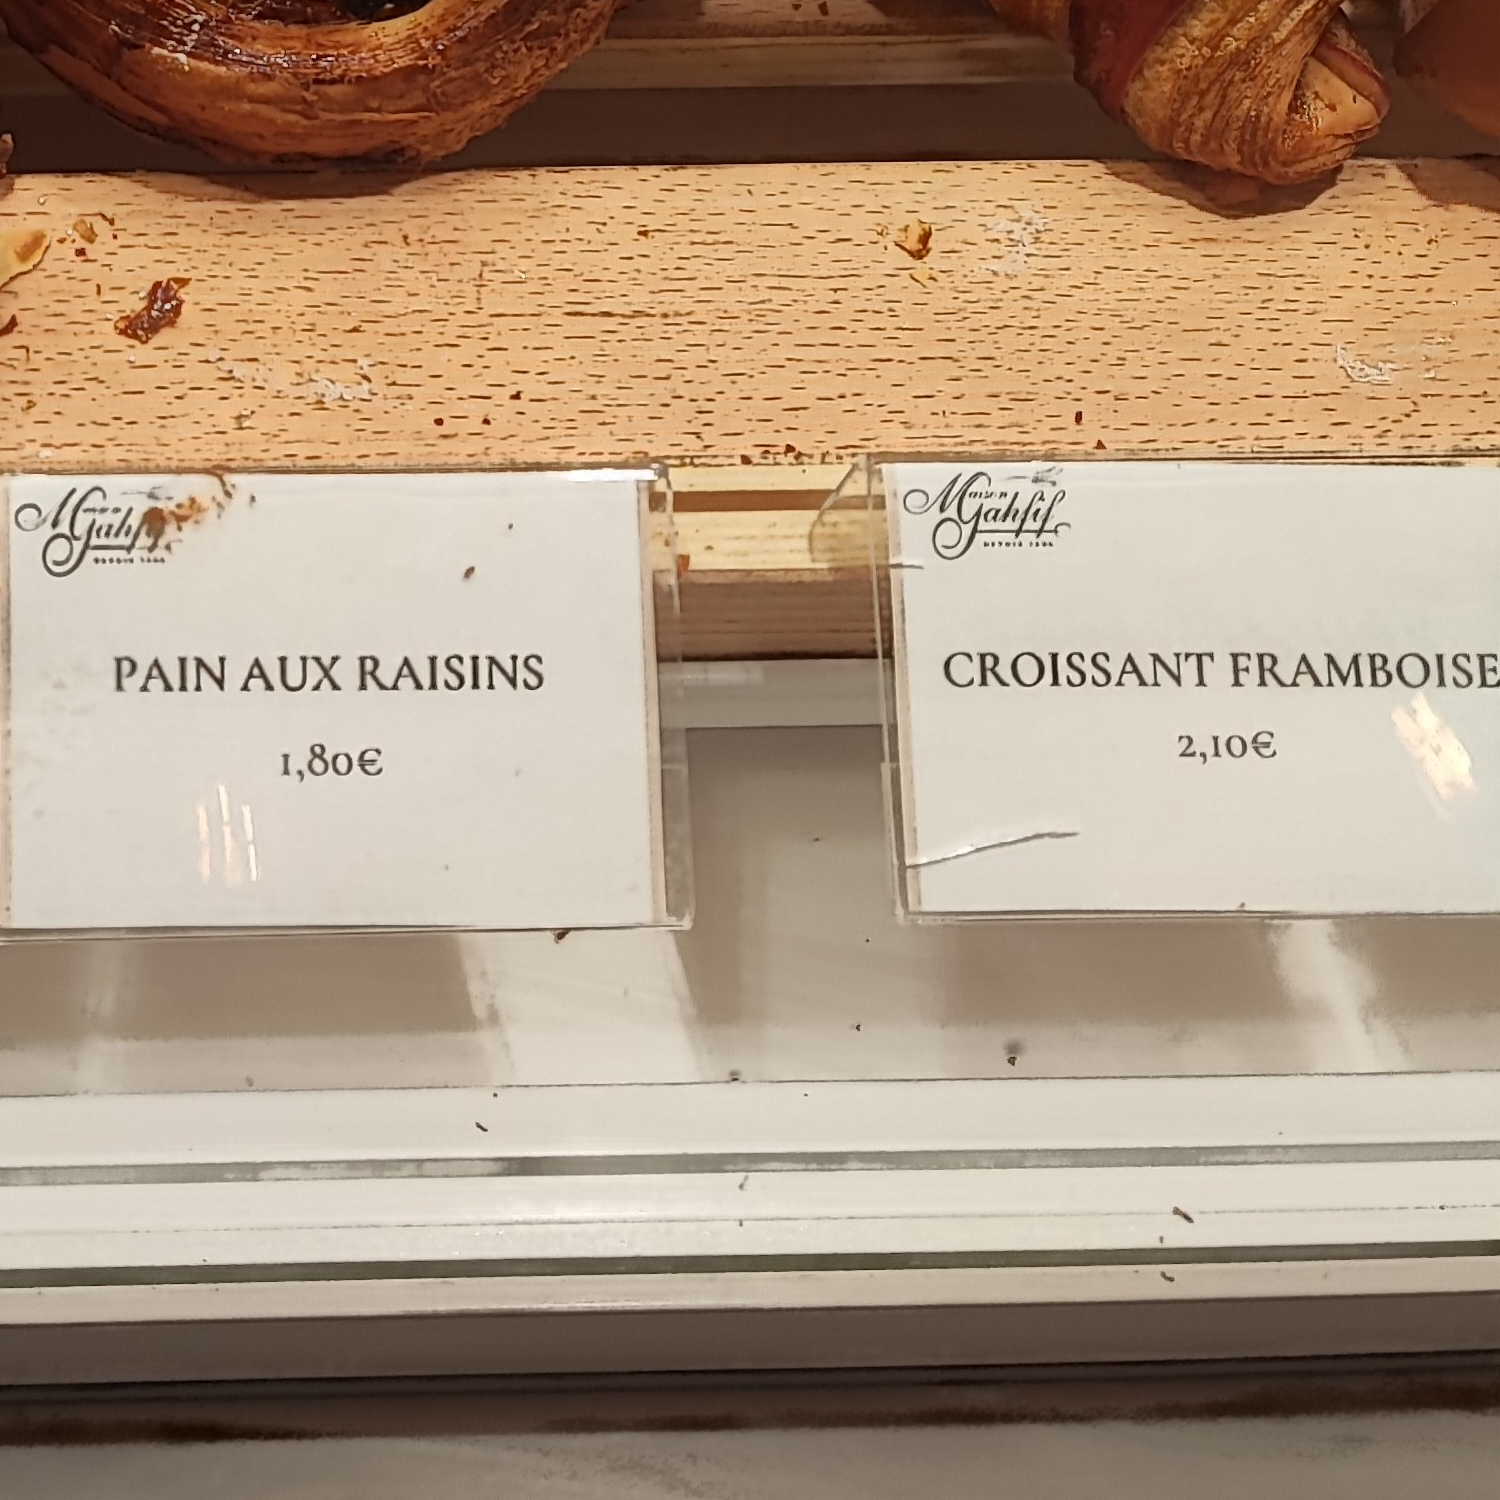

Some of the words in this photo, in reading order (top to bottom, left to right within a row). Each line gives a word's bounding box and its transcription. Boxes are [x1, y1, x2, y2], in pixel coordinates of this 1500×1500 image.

[113, 655, 227, 693] PAIN
[239, 654, 343, 693] AUX
[357, 653, 545, 692] RAISINS
[942, 651, 1215, 689] CROISSANT
[1228, 651, 1500, 689] FRAMBOISE
[281, 742, 384, 783] 1,80€
[1177, 730, 1277, 765] 2,10€
